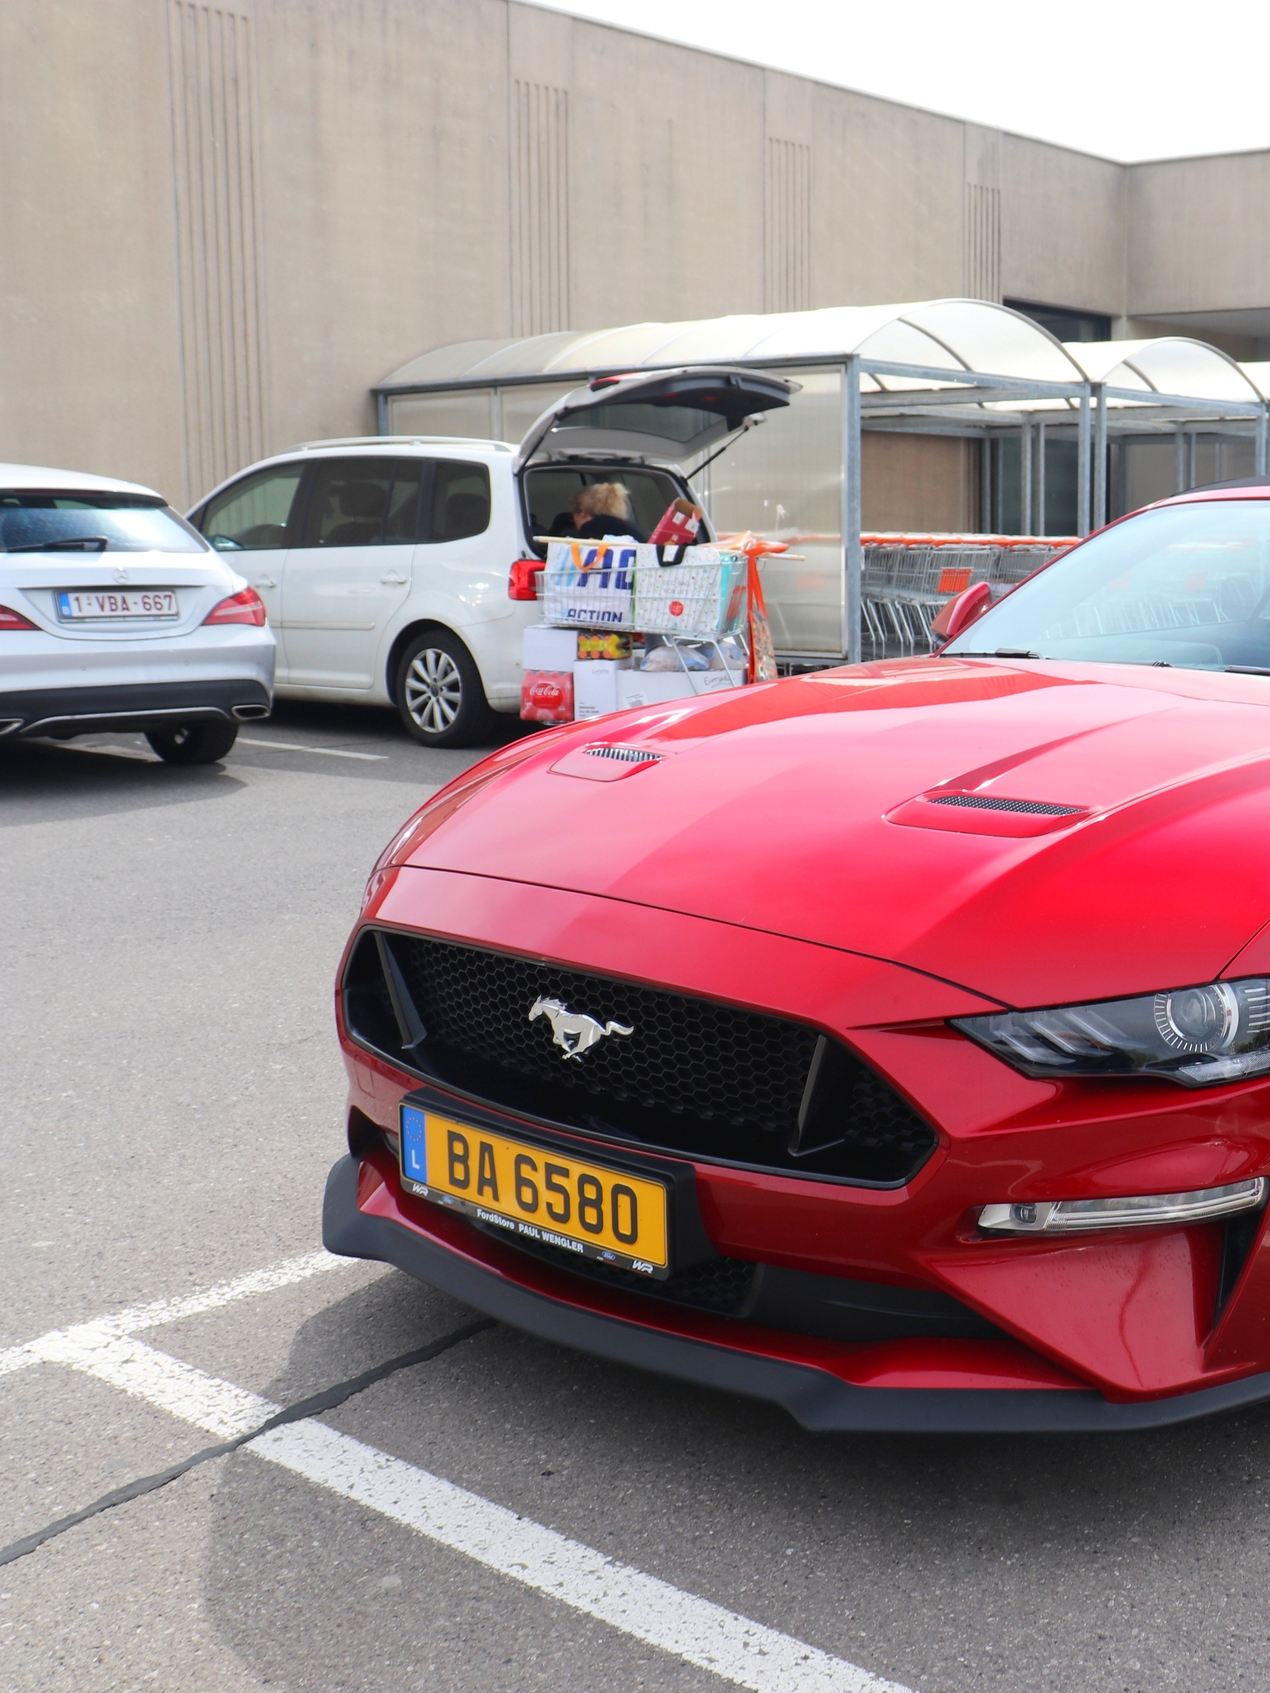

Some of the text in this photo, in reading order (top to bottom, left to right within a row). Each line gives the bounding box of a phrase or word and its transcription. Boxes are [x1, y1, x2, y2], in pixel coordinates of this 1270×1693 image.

[567, 608, 623, 623] ACTION
[703, 674, 735, 688] Everyd
[411, 1149, 420, 1170] L
[447, 1129, 638, 1245] BA 6580
[476, 1208, 584, 1253] FordStore PAUL WENGLER
